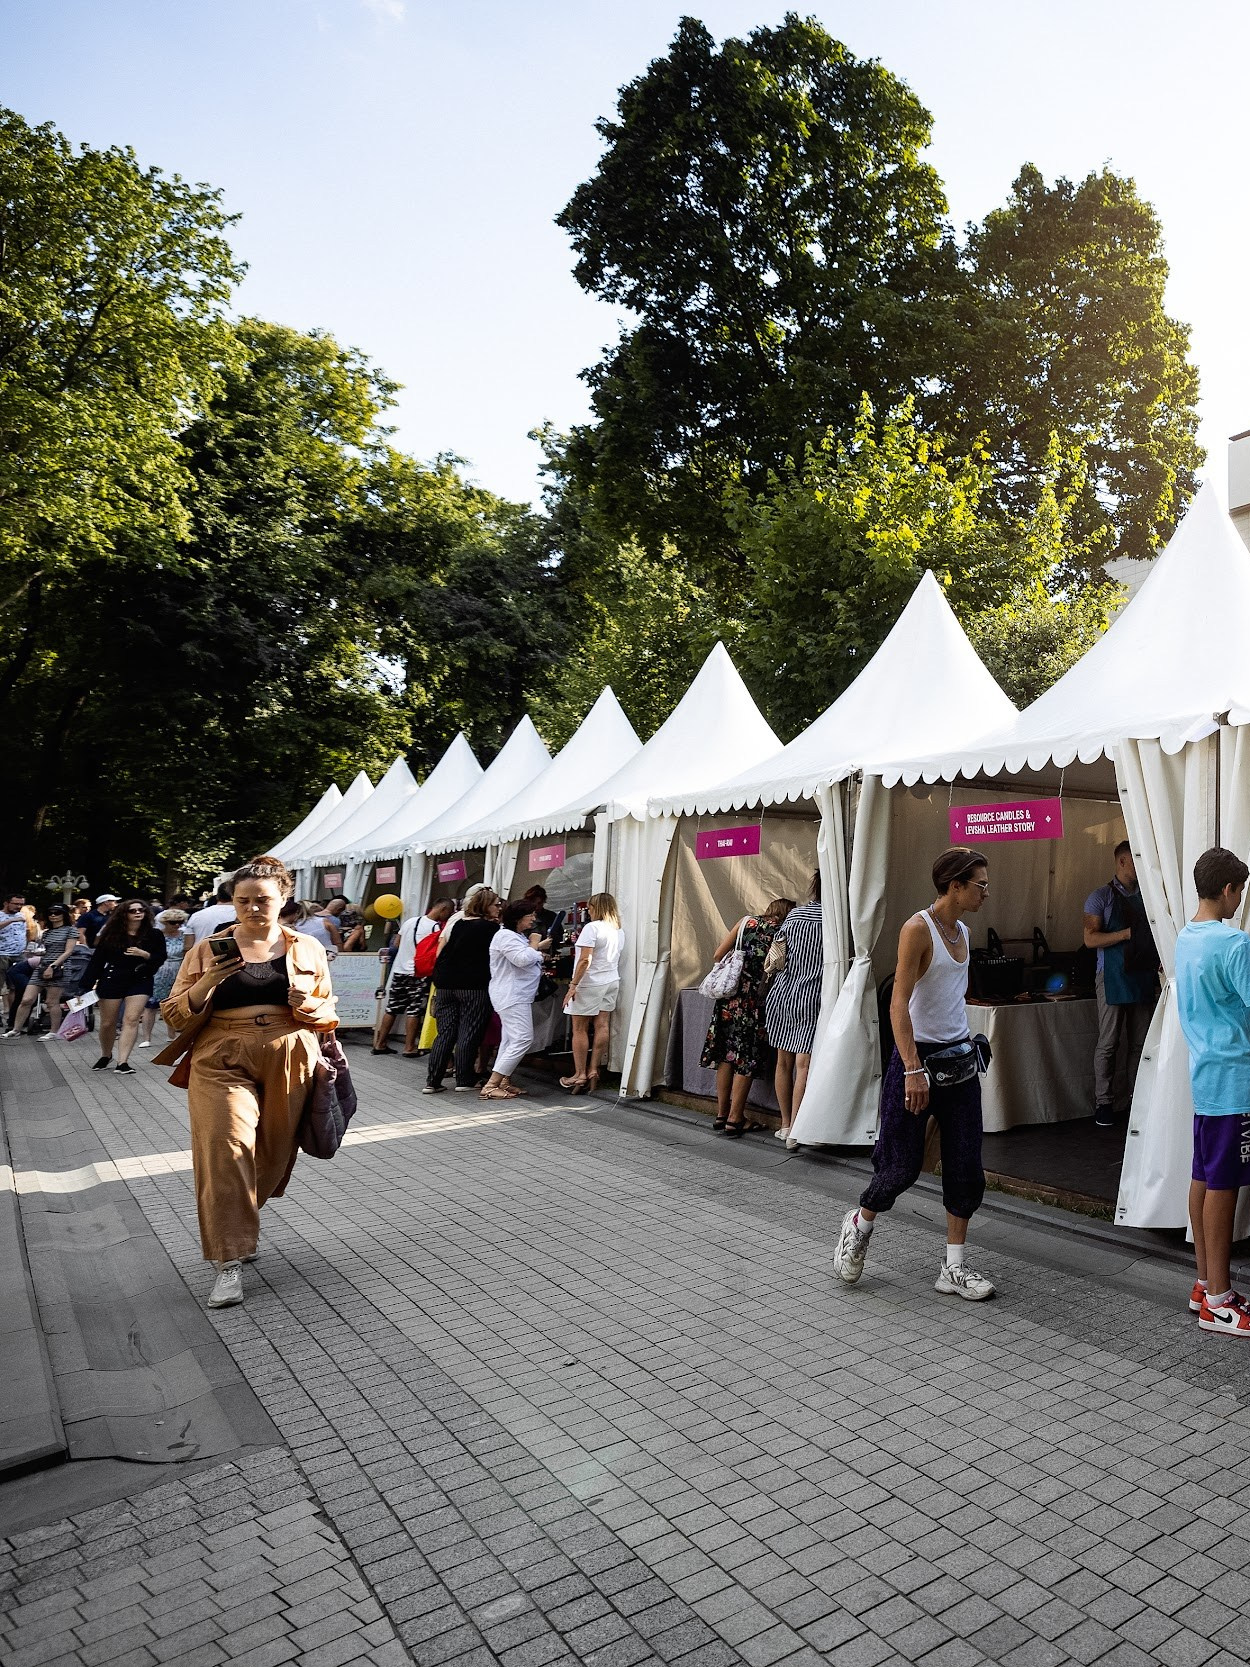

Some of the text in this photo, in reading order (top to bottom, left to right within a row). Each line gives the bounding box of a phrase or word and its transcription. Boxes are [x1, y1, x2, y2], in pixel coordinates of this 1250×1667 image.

[967, 809, 1031, 823] RESOURCE CANDLES &
[986, 823, 1013, 834] LEATHER
[1014, 821, 1035, 832] STORY
